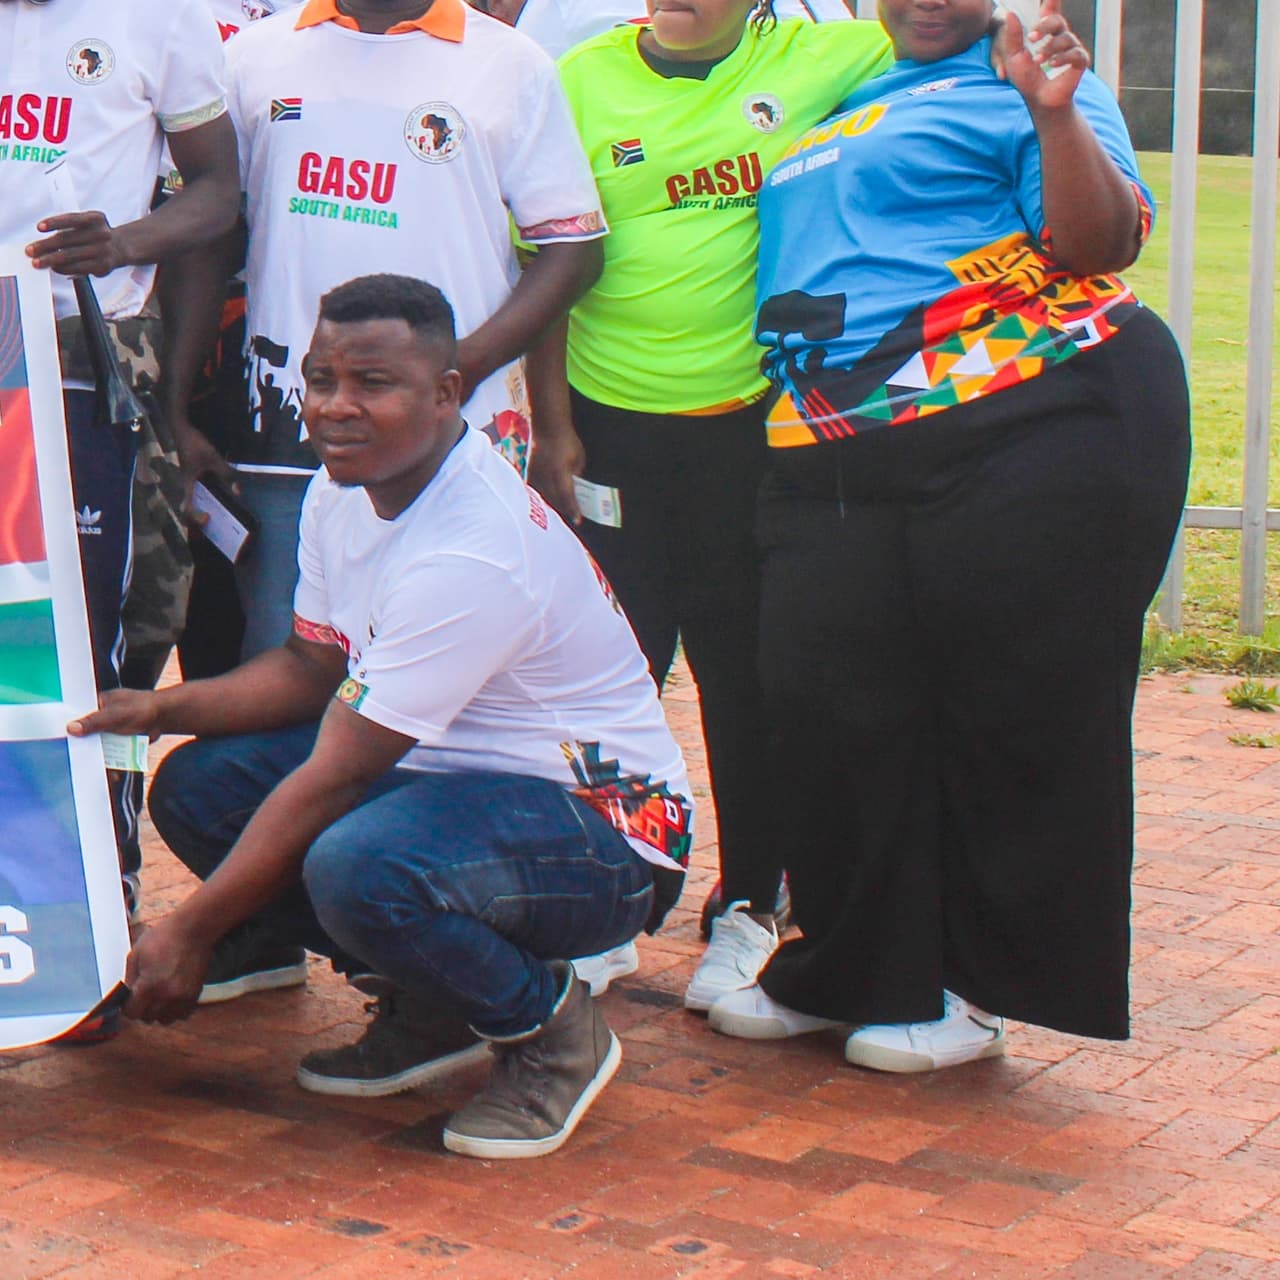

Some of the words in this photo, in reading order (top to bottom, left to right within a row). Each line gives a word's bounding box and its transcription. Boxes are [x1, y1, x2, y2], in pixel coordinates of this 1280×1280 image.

[298, 152, 397, 204] GASU
[666, 152, 762, 205] GASU
[771, 160, 804, 186] SOUTH
[805, 147, 839, 172] AFRICA
[289, 197, 340, 219] SOUTH
[342, 206, 398, 229] AFRICA
